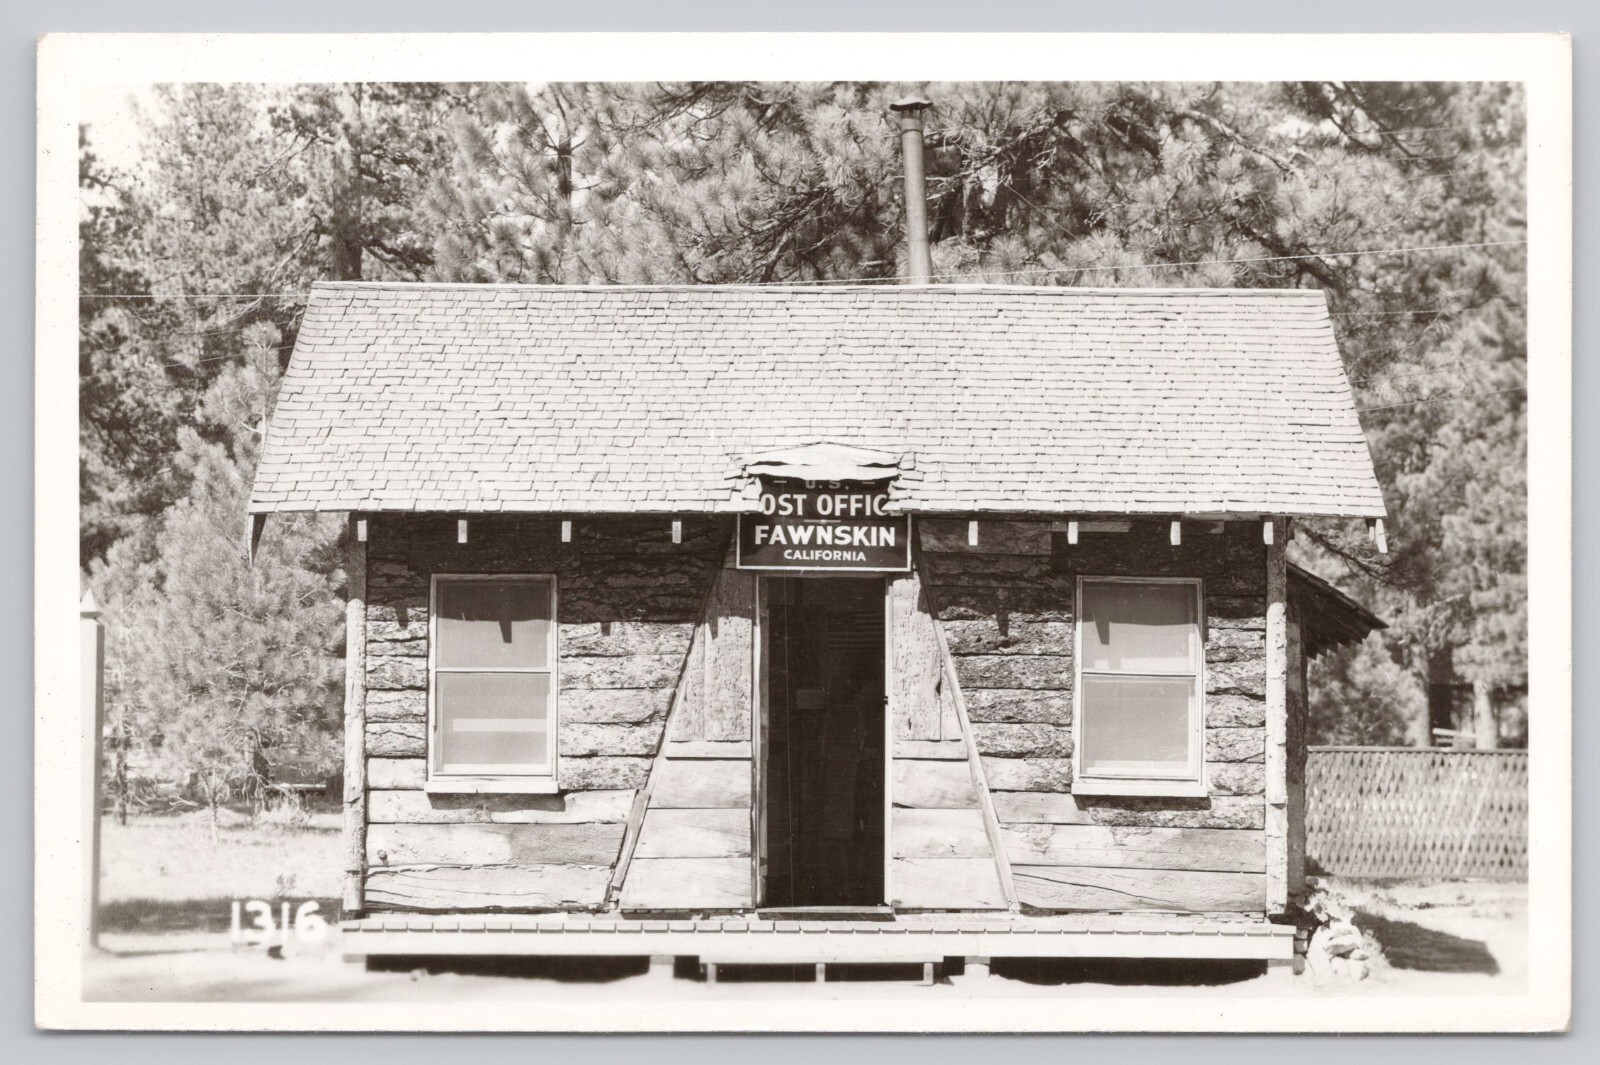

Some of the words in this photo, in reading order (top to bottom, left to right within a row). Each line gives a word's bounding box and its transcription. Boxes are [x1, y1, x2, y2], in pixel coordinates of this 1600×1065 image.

[757, 493, 807, 516] OST
[816, 494, 904, 517] OFFIC
[755, 525, 896, 547] FAWNSKIN
[783, 549, 866, 562] CALIFORNIA
